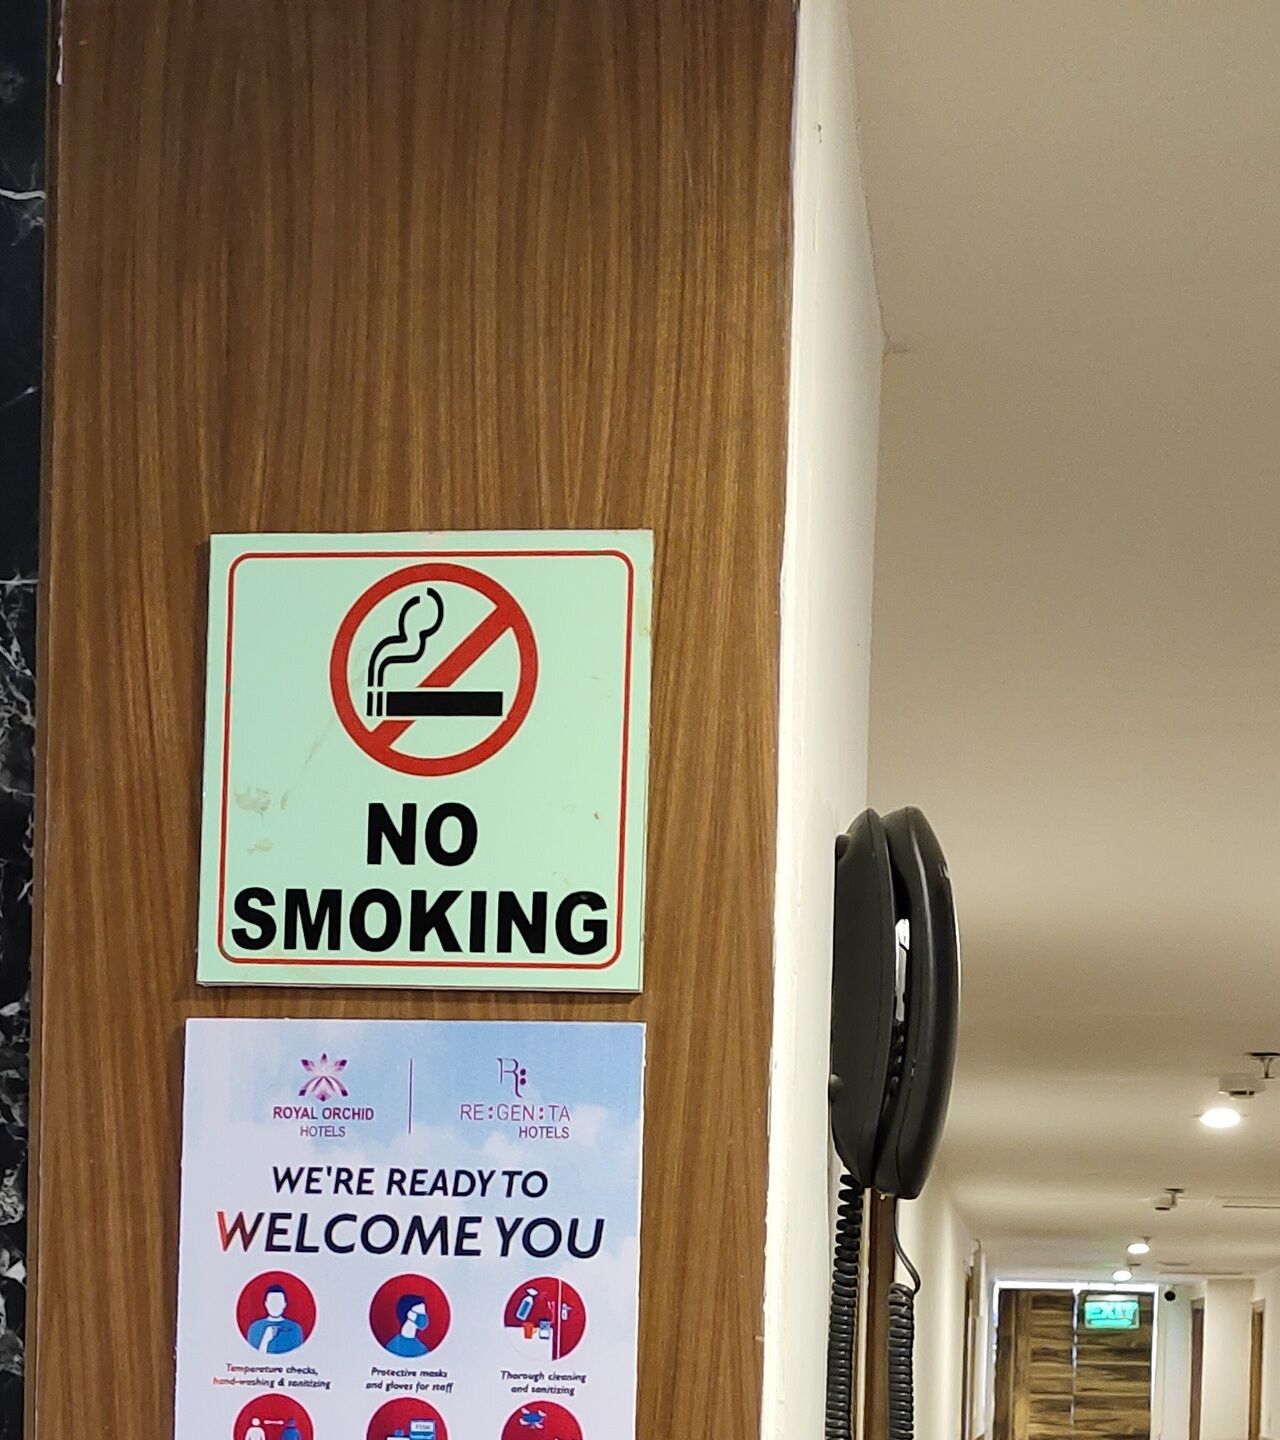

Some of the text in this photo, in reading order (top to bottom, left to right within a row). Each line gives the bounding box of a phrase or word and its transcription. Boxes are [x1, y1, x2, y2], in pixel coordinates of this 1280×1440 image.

[366, 802, 478, 867] NO
[231, 886, 608, 956] SMOKING
[273, 1105, 374, 1121] ROYAL ORCHID
[300, 1125, 346, 1138] HOTELS
[519, 1126, 570, 1139] HOTELS
[273, 1166, 549, 1198] WE'RE READY TO
[216, 1211, 605, 1259] WELCOME YOU
[226, 1363, 283, 1374] Temperature
[371, 1366, 448, 1377] Protective masks
[500, 1370, 587, 1383] Thorough cleaning
[365, 1380, 454, 1393] and gloves for staff
[511, 1384, 575, 1396] and sanitizing
